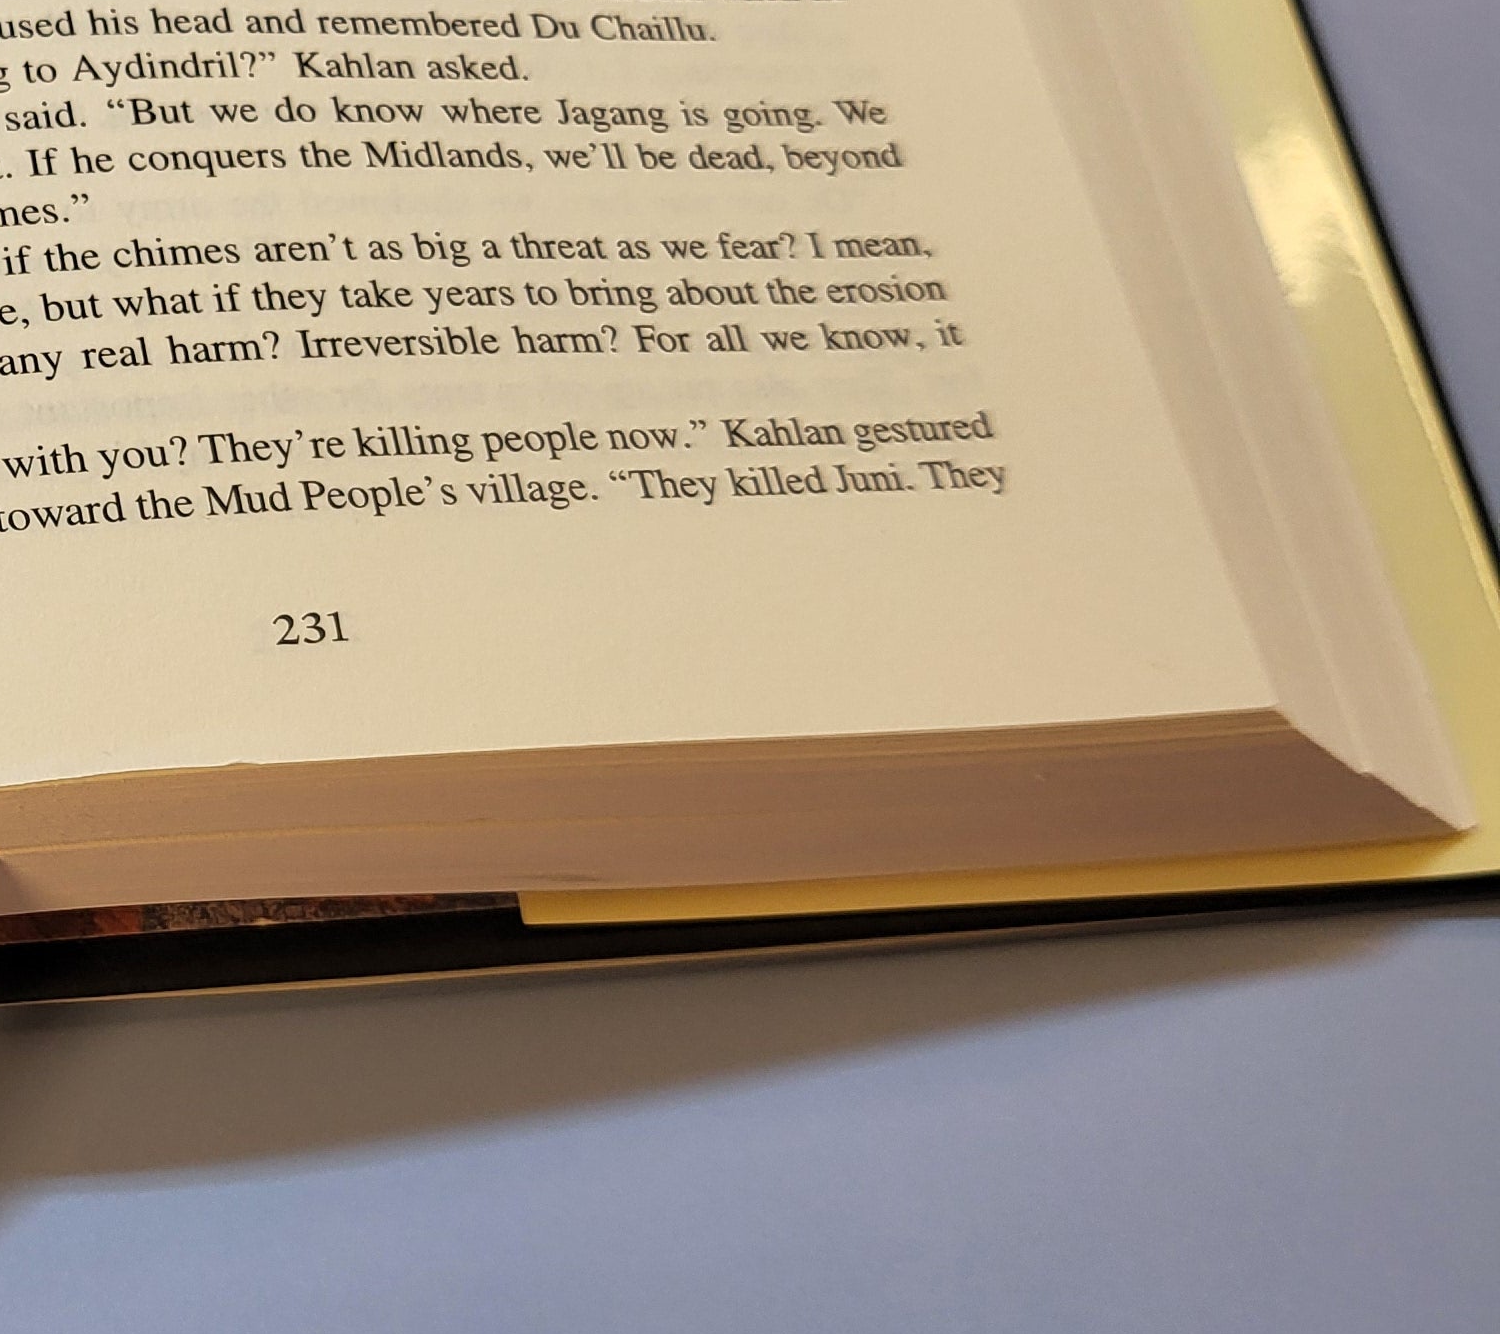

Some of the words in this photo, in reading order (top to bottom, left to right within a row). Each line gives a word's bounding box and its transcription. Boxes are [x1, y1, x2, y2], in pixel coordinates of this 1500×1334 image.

[4, 99, 87, 132] said.
[106, 96, 196, 126] “But
[208, 102, 259, 124] we
[274, 94, 317, 123] do
[329, 94, 425, 124] know
[439, 96, 543, 125] where
[555, 97, 671, 134] Jagang
[679, 99, 711, 127] is
[723, 100, 825, 134] going.
[830, 98, 889, 126] We
[79, 335, 154, 370] real
[164, 330, 280, 365] harm?
[294, 325, 501, 359] Irreversible
[510, 324, 619, 354] harm?
[630, 324, 693, 354] For
[705, 322, 752, 353] all
[759, 330, 811, 352] we
[817, 322, 928, 352] know,
[933, 318, 967, 348] it
[0, 442, 90, 479] with
[96, 435, 188, 481] you?
[196, 424, 345, 470] They’re
[355, 423, 475, 462] killing
[480, 421, 600, 457] people
[604, 419, 707, 451] now.”
[718, 416, 849, 448] Kahlan
[853, 410, 997, 453] gestured
[134, 488, 196, 521] the
[200, 480, 294, 517] Mud
[297, 475, 459, 518] People’s
[465, 472, 599, 511] village.
[608, 468, 718, 507] “They
[724, 465, 824, 498] killed
[831, 463, 915, 496] Juni.
[924, 459, 1007, 494] They
[272, 610, 350, 646] 231
